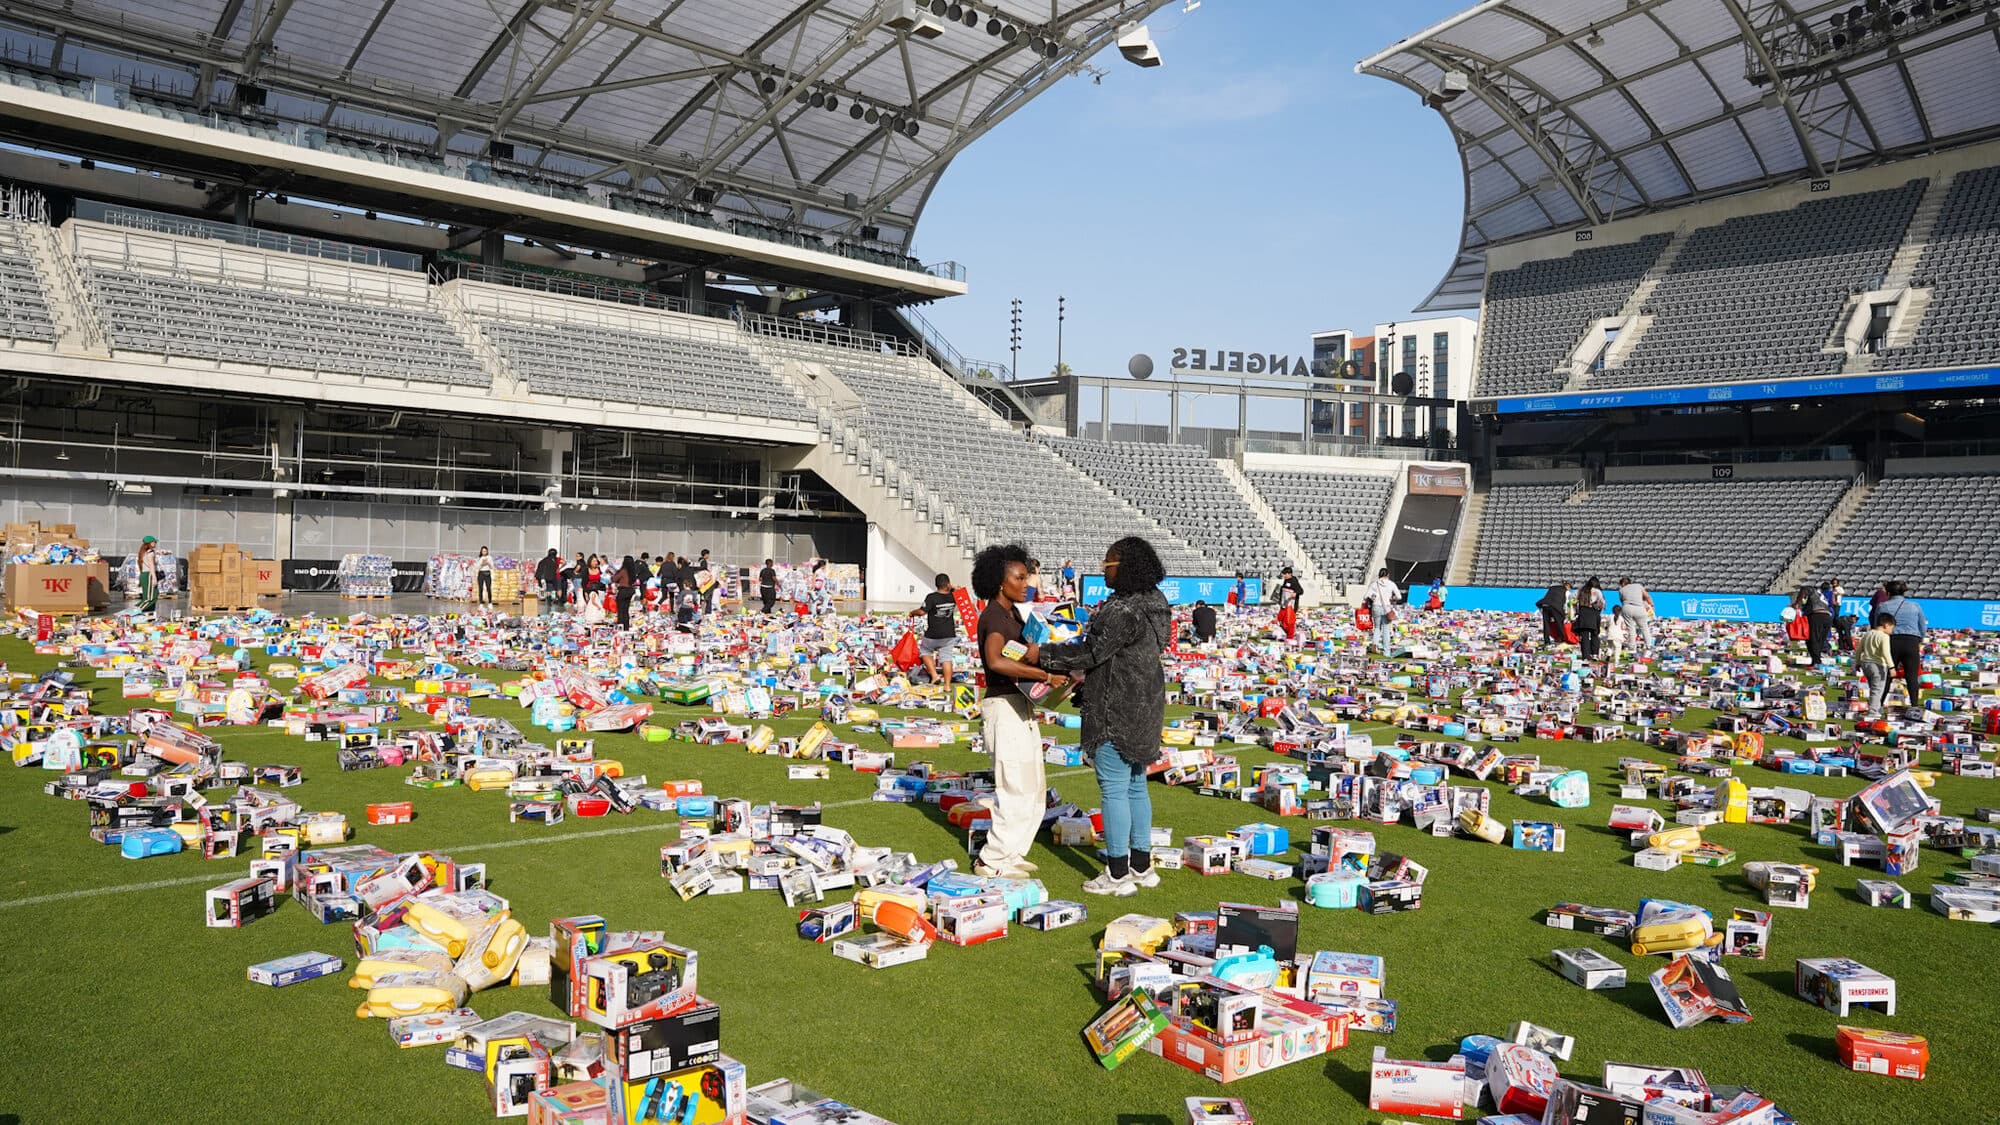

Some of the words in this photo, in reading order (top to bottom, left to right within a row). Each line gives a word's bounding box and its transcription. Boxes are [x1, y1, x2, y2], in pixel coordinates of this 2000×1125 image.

[1812, 183, 1828, 191] 209
[1580, 396, 1624, 405] RITFIT
[1714, 468, 1731, 477] 109
[1413, 473, 1432, 487] TKF
[41, 578, 73, 593] TKF
[1701, 606, 1717, 614] TOY
[1717, 606, 1745, 615] DRIVE
[1848, 988, 1889, 996] TRANSFORMERS
[1116, 1022, 1155, 1062] SUBWAY
[1647, 1111, 1675, 1121] VENOM
